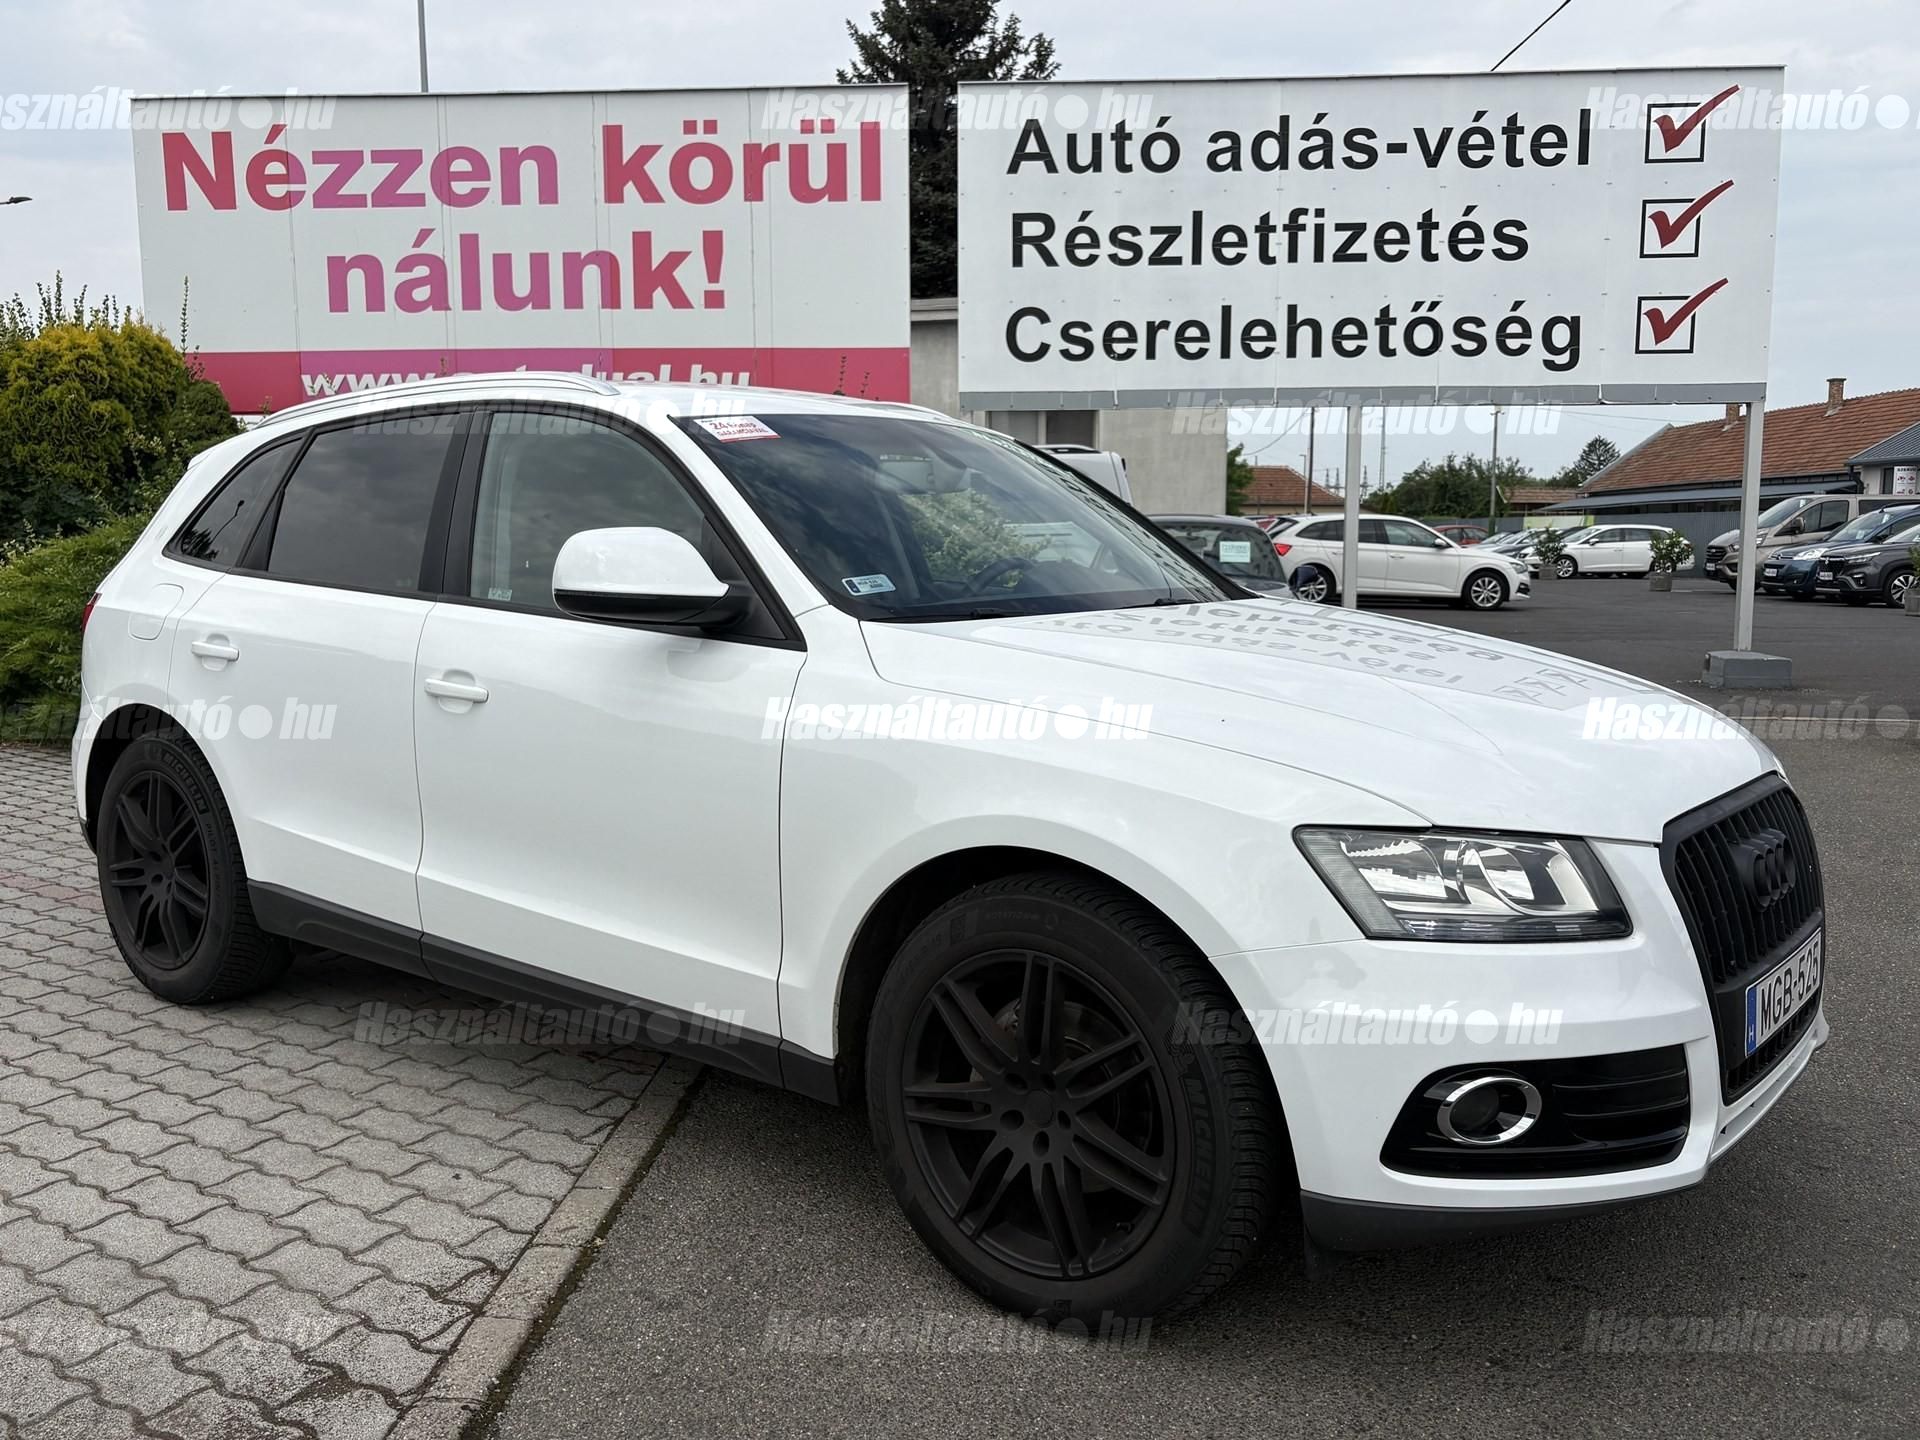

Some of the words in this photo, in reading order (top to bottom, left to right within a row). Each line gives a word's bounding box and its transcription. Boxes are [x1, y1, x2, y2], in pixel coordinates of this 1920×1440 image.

[162, 124, 558, 211] Nézzen
[603, 119, 882, 205] körül
[1006, 116, 1181, 175] Autó
[1206, 108, 1591, 173] adás-vétel
[328, 229, 725, 312] nálunk!
[1012, 204, 1529, 268] Részletfizetés
[1005, 300, 1581, 372] Cserelehetőség
[1760, 941, 1820, 1037] MGB-525
